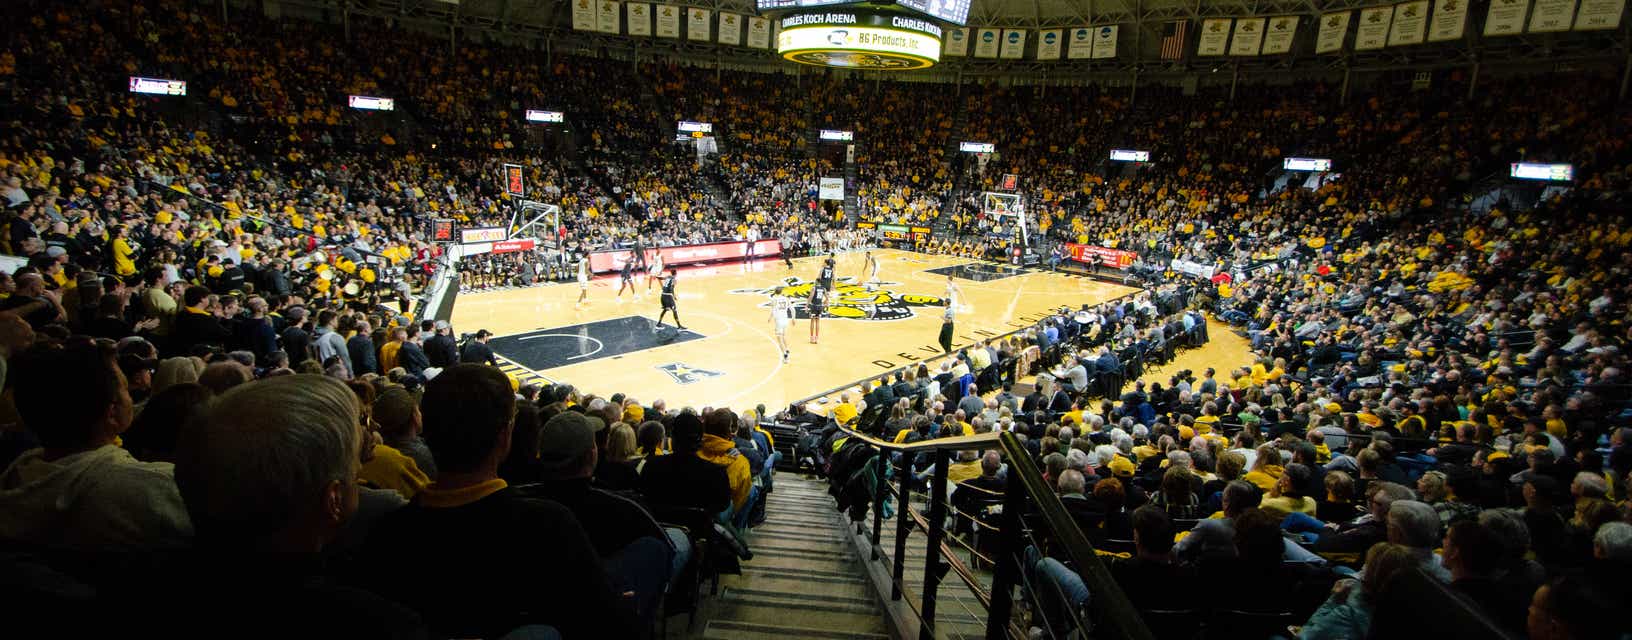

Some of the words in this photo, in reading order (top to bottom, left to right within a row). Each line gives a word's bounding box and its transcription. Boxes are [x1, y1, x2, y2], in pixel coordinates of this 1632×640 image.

[783, 15, 803, 28] CHARLES
[804, 13, 824, 25] KOCH
[825, 12, 857, 24] ARENA
[892, 16, 925, 32] CHARLES
